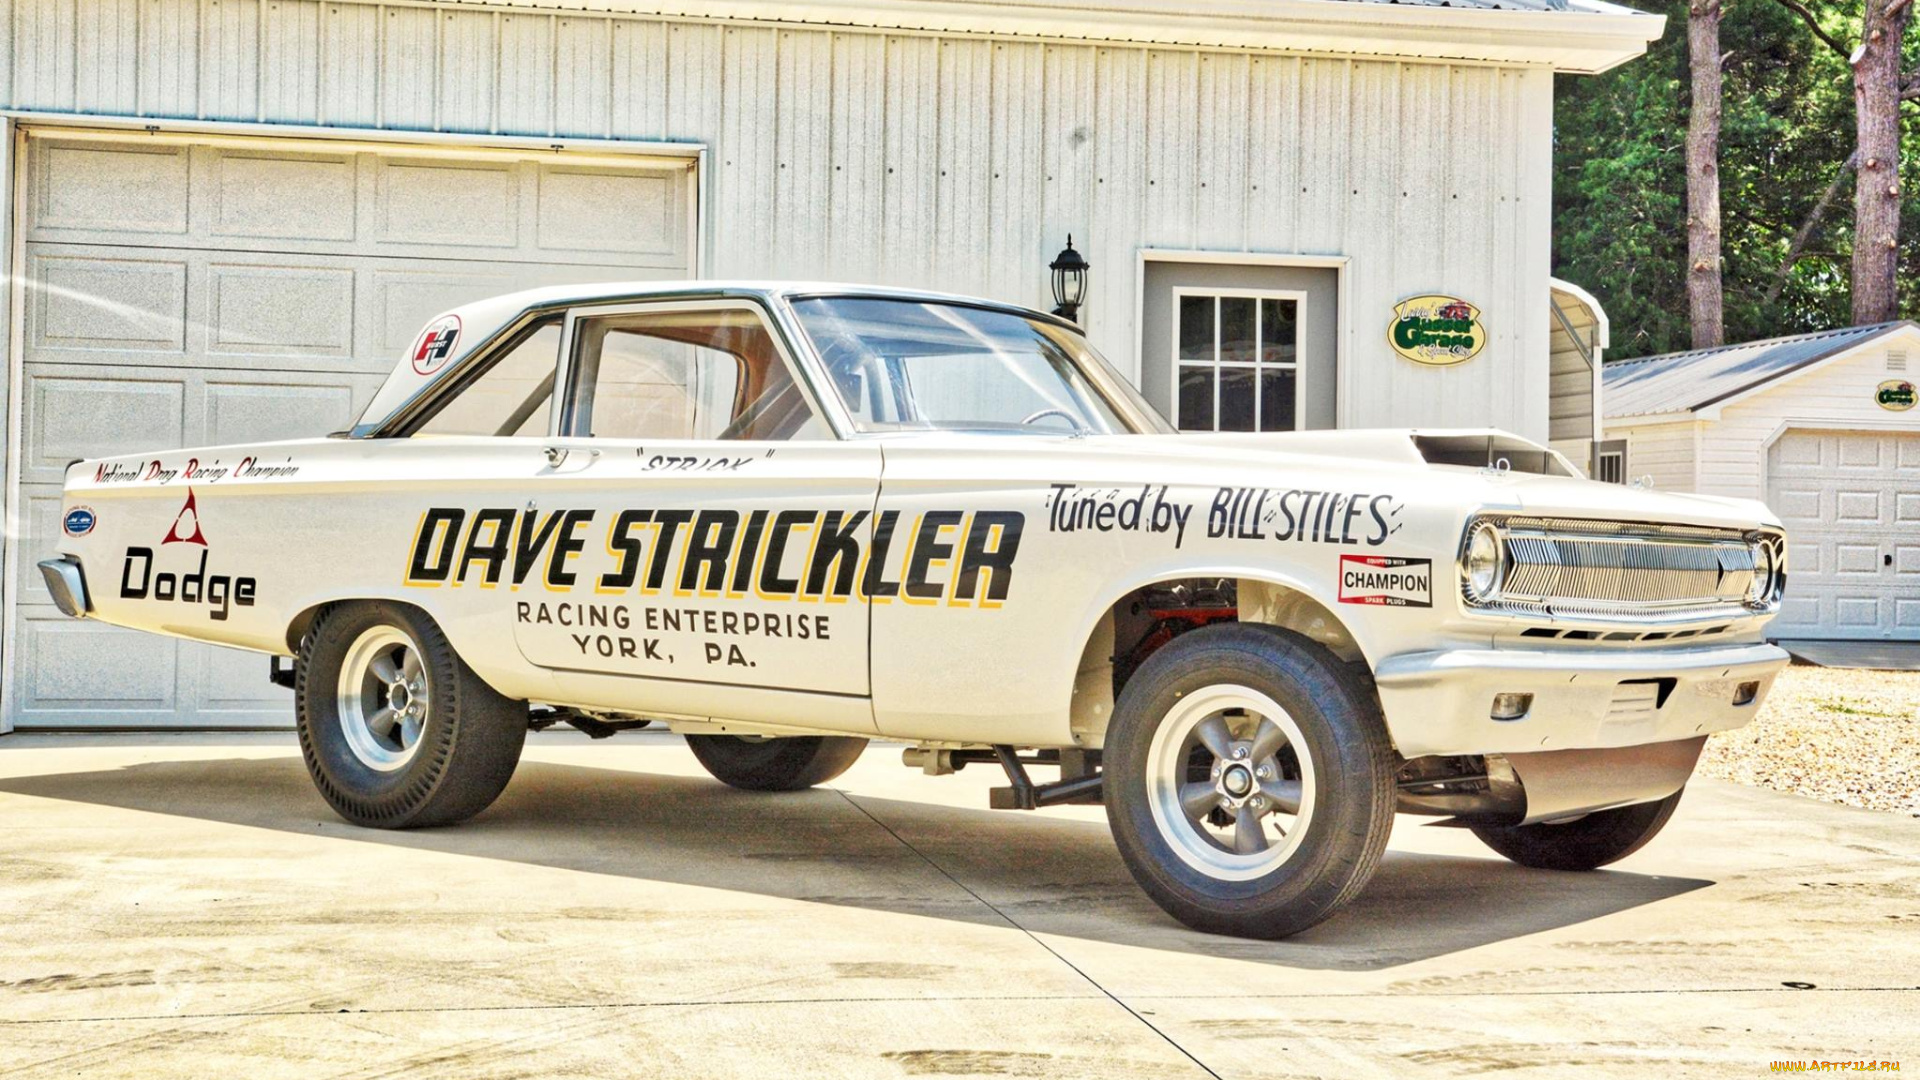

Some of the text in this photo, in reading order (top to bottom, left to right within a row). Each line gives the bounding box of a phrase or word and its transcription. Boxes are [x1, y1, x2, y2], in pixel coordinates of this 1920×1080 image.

[94, 456, 300, 485] National Drag Racing Champion
[1049, 483, 1393, 549] Tuned by BILL STILES
[402, 508, 1025, 609] DAVE STRICKLER
[120, 546, 256, 621] Dodge
[1344, 571, 1427, 591] CHAMPION
[1365, 596, 1385, 604] SPARK
[517, 601, 831, 640] RACING ENTERPRISE
[571, 633, 757, 667] YORK, PA.
